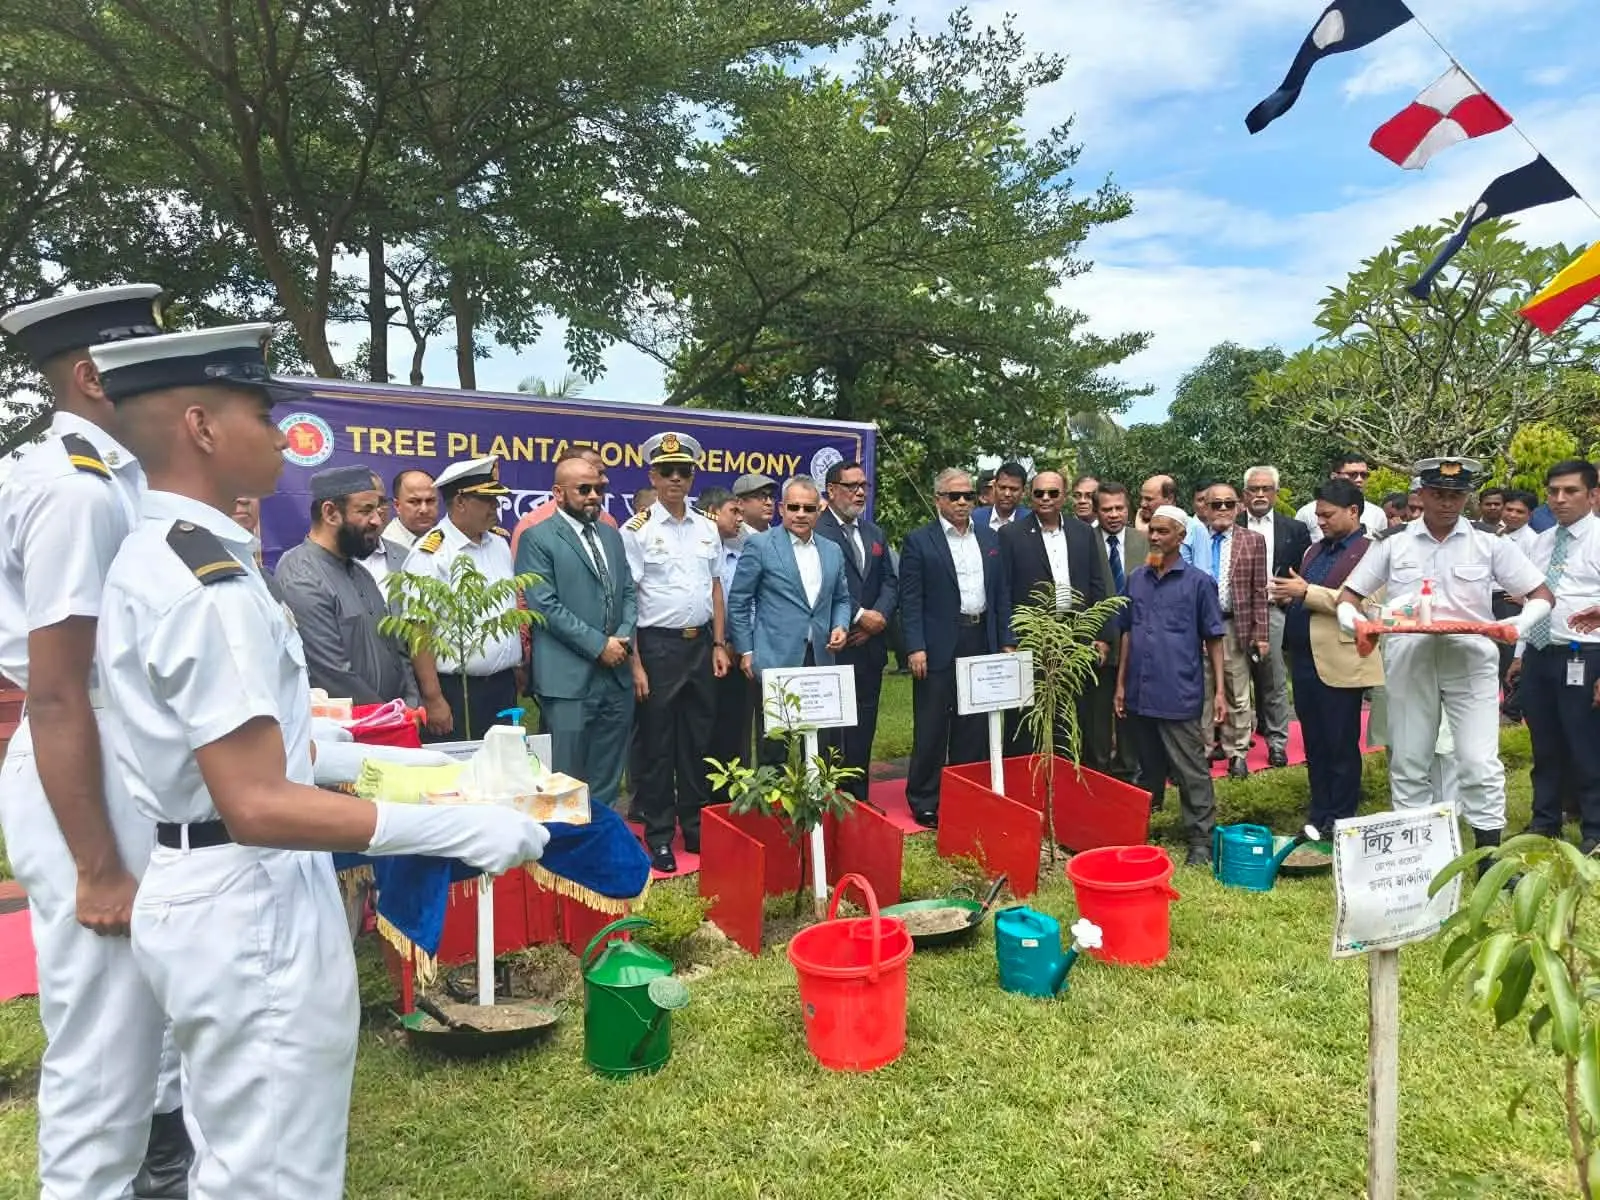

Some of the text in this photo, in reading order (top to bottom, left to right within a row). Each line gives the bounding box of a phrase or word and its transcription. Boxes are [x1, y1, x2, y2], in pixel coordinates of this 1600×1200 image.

[346, 426, 436, 457] TREE
[1362, 823, 1433, 854] লিচু গাছ
